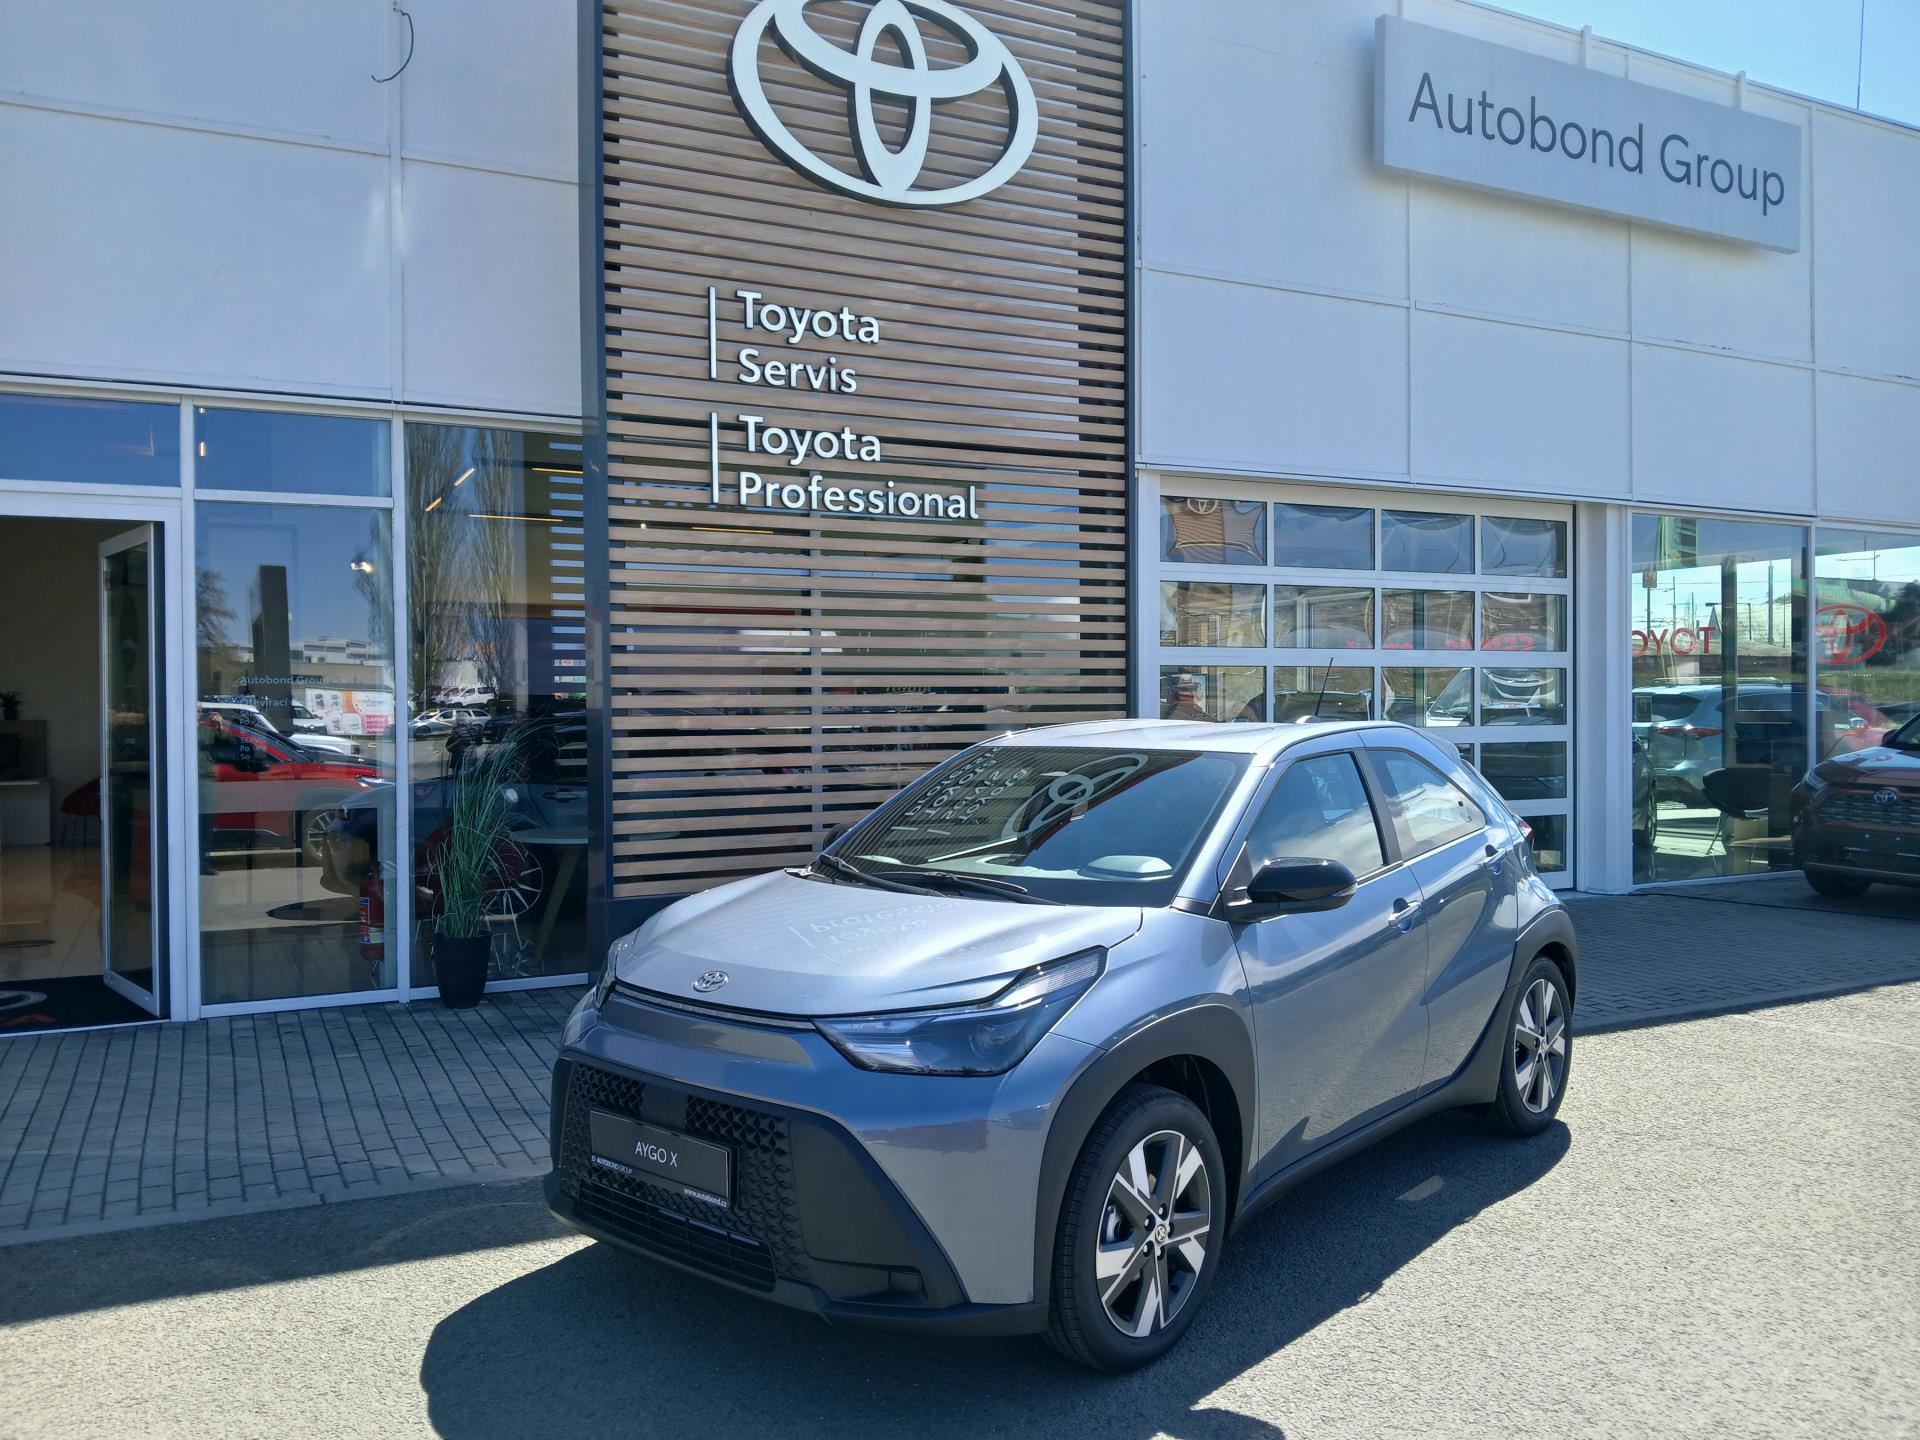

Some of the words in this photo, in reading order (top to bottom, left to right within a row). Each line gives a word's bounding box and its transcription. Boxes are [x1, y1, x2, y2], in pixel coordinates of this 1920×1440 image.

[1408, 71, 1645, 174] Autobond
[1659, 133, 1786, 216] Group
[735, 290, 880, 344] Toyota
[738, 348, 858, 393] Servis
[738, 414, 882, 466] Toyota
[739, 471, 980, 520] Professional
[240, 675, 293, 686] Autobond
[296, 676, 330, 687] Group
[635, 1141, 667, 1164] AYGO
[670, 1151, 678, 1168] X
